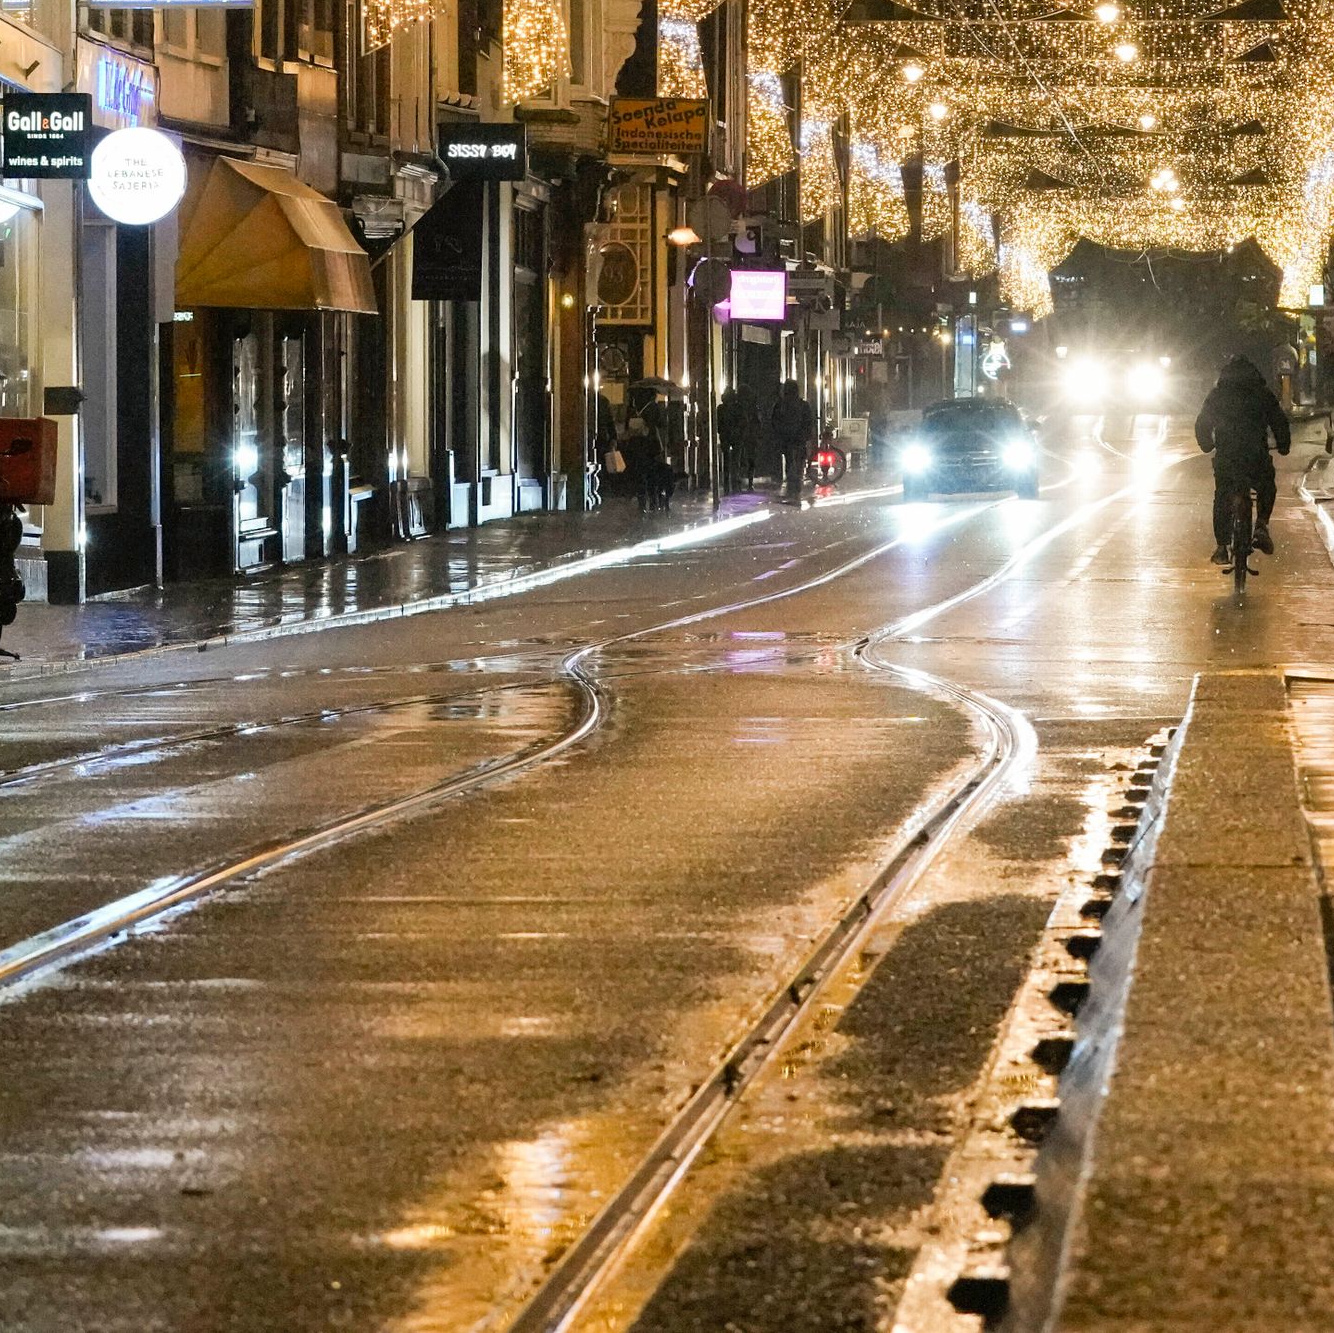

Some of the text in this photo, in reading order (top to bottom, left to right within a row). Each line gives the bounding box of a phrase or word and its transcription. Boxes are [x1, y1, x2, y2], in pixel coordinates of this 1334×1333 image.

[616, 127, 702, 140] Indonesische
[614, 138, 702, 151] Specialiteiten
[447, 143, 517, 160] SISSY BOY
[8, 155, 83, 169] wines & spirits
[124, 157, 147, 167] THE
[107, 168, 164, 178] LEBANESE
